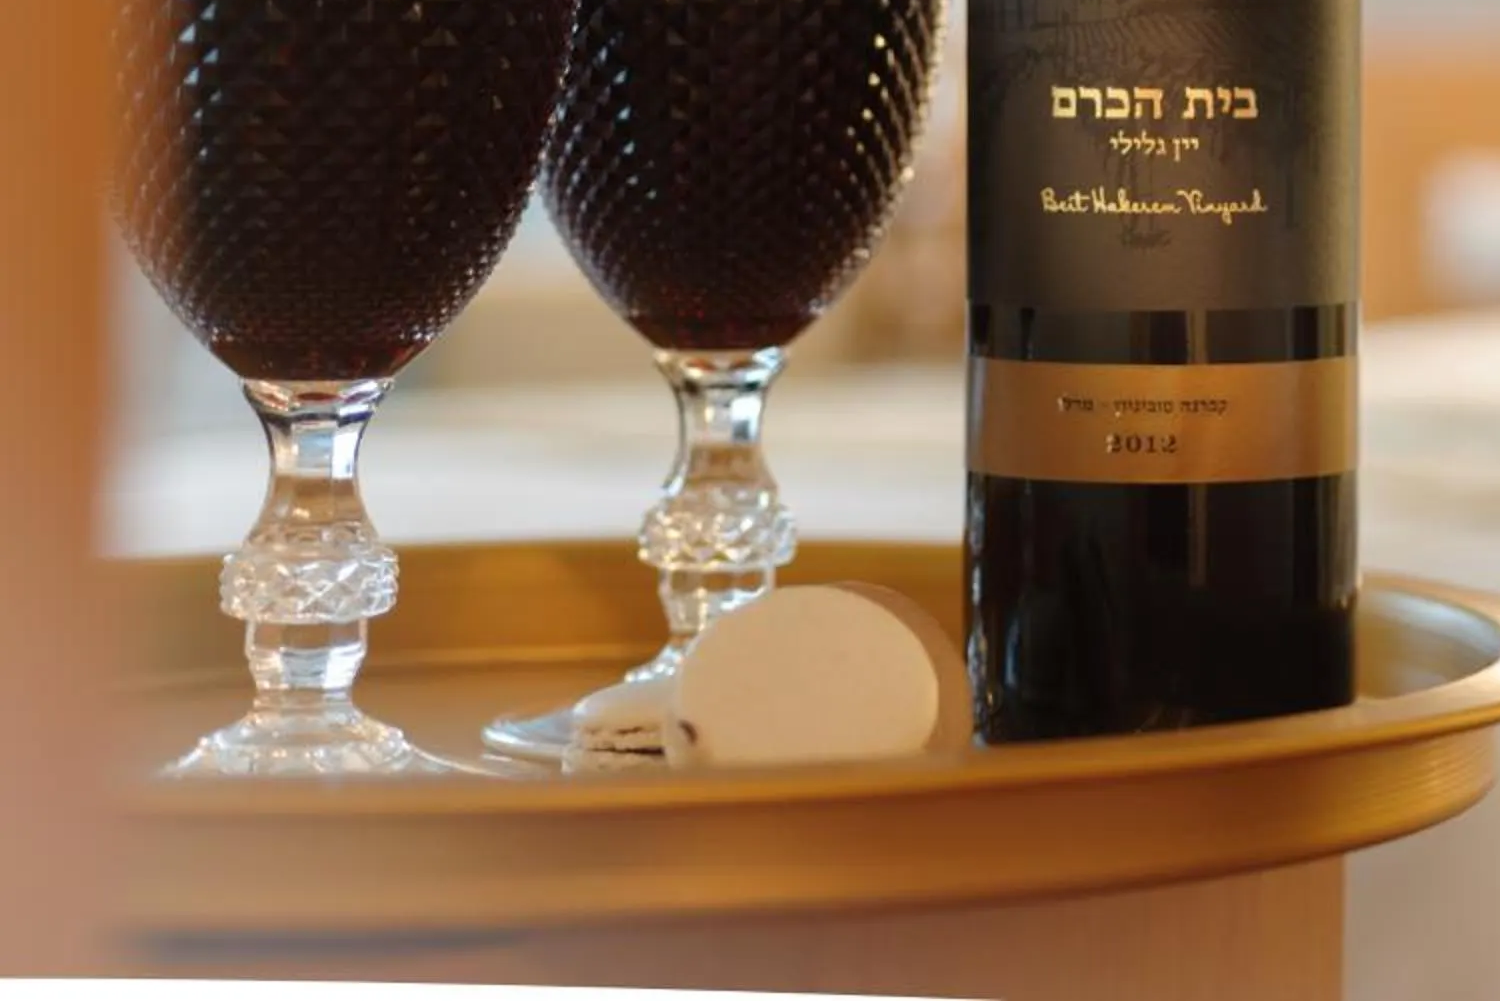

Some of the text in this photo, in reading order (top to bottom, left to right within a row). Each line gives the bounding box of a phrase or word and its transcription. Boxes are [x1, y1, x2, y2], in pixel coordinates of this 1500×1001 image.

[1051, 85, 1259, 120] בית הכרם
[1109, 130, 1201, 162] יין גלילי
[1040, 187, 1090, 213] Beit
[1105, 433, 1179, 455] 2012
